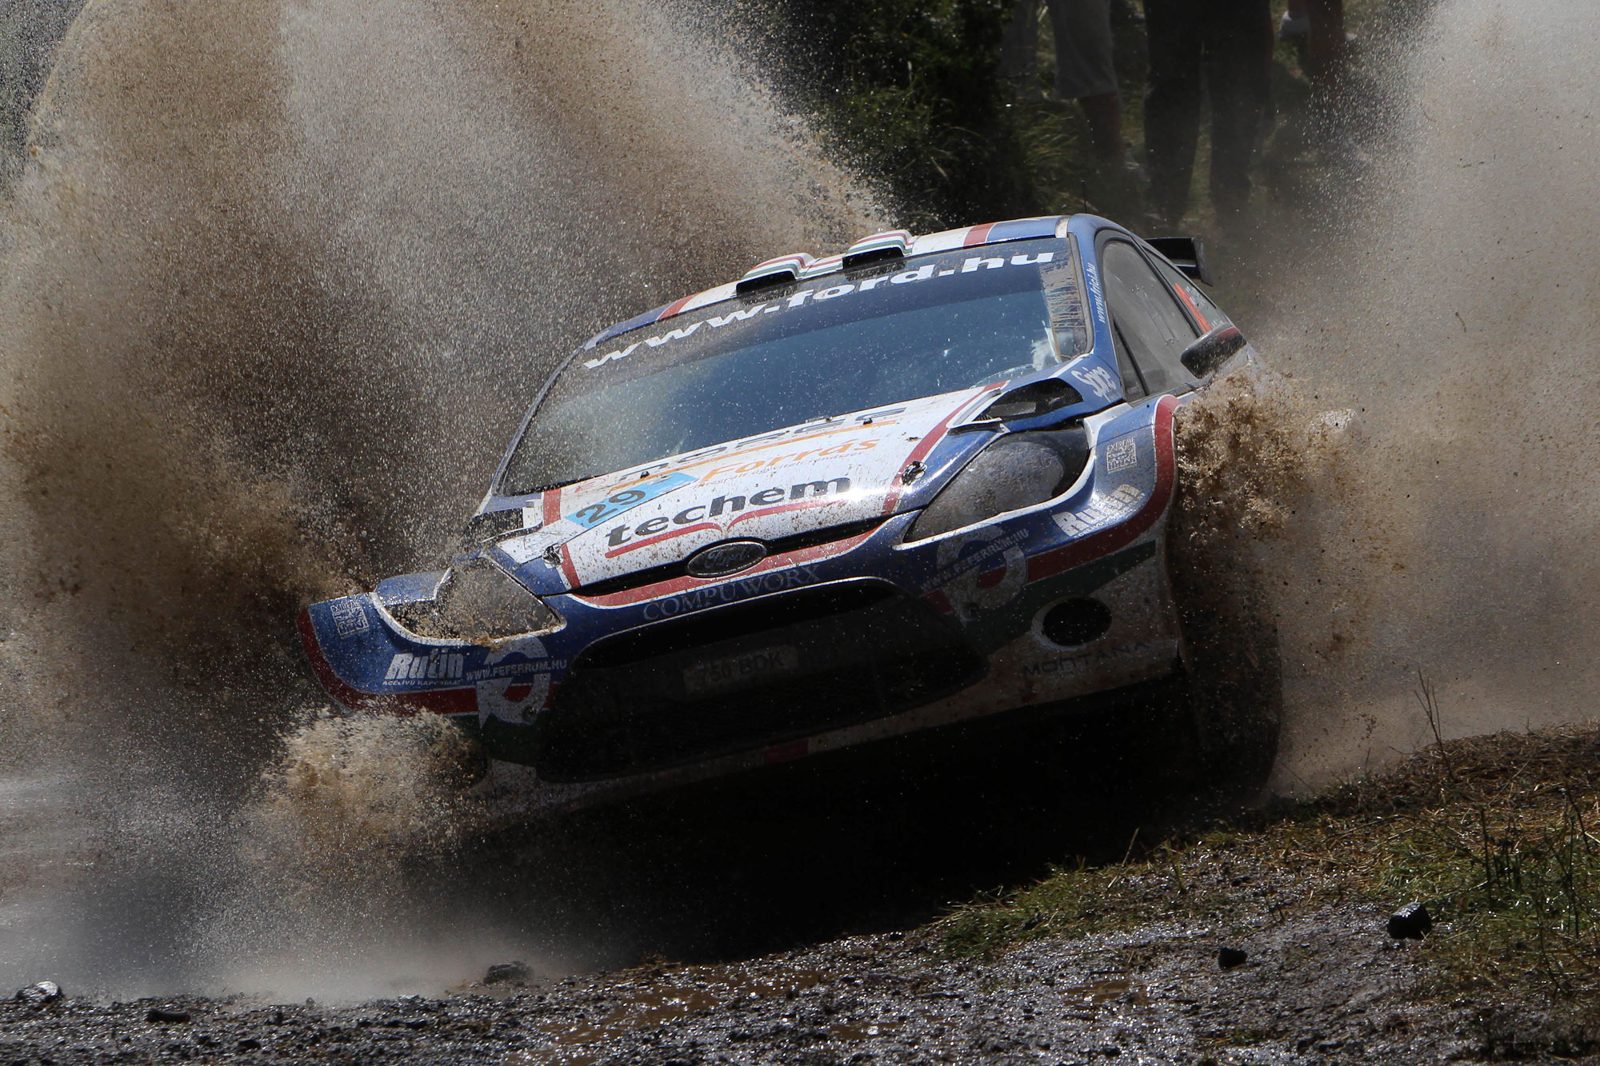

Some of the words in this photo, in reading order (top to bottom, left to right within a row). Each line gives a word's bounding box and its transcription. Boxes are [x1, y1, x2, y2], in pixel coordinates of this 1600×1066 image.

[584, 252, 1054, 370] www.ford.hu
[576, 489, 646, 524] 29
[605, 478, 851, 548] techem
[643, 566, 820, 621] COMPUWORX
